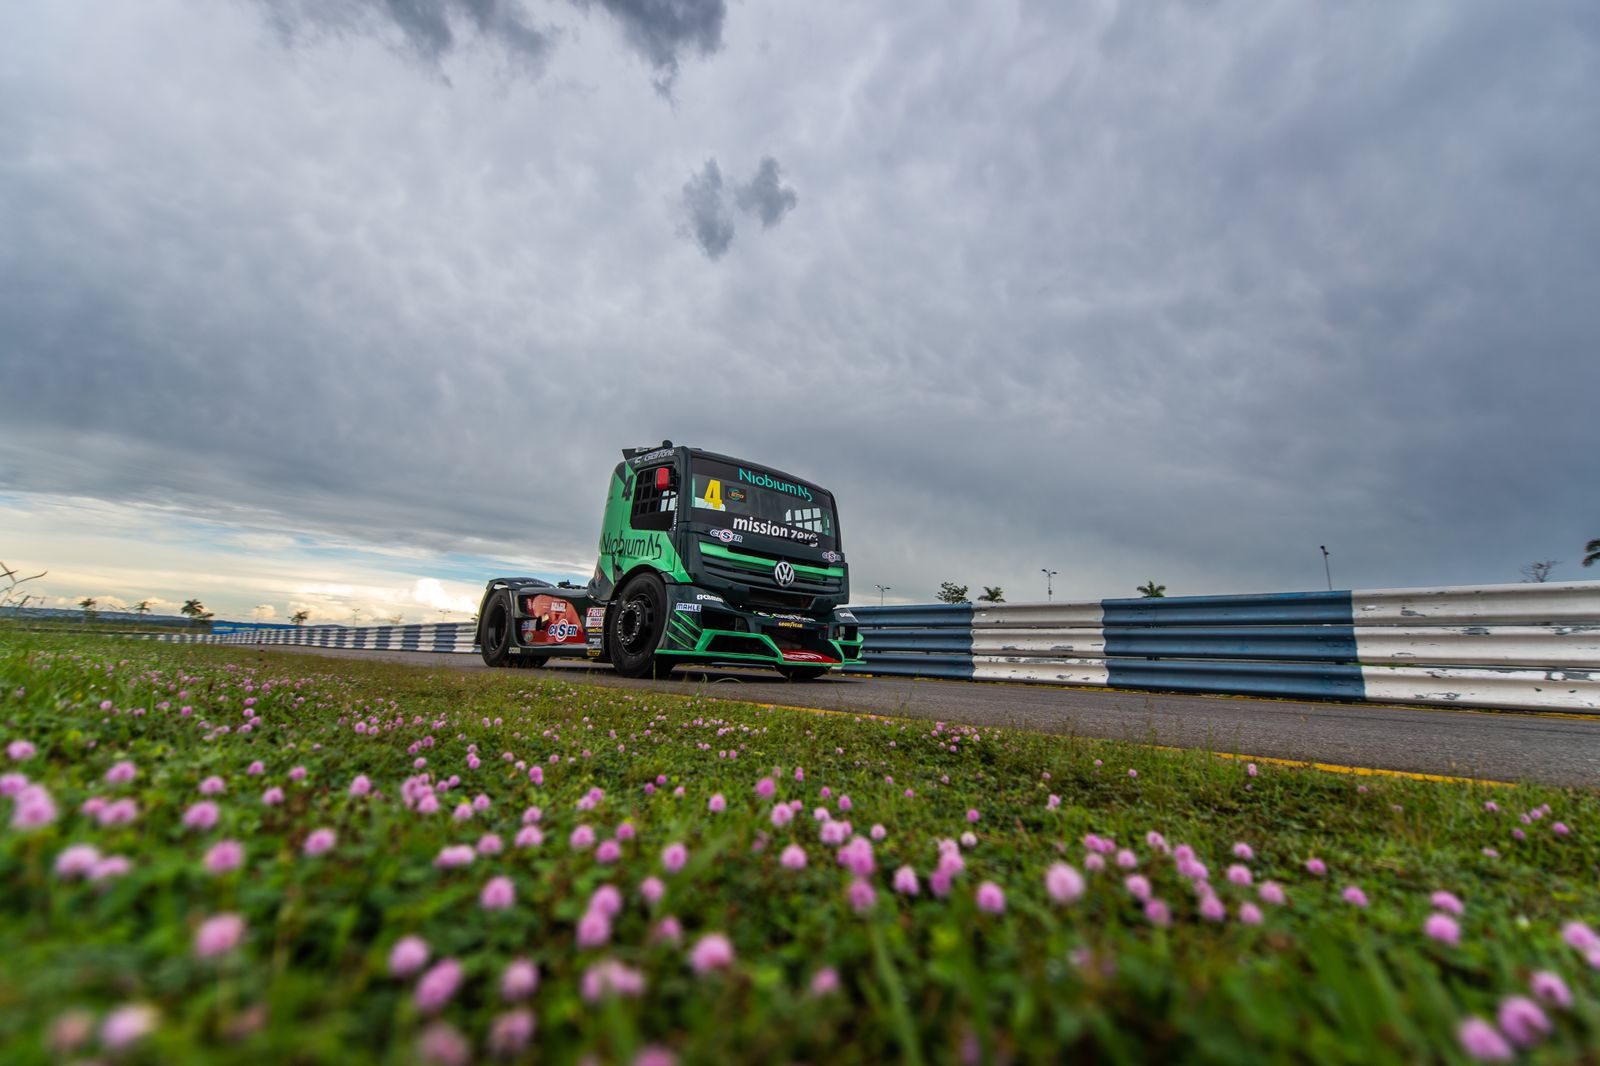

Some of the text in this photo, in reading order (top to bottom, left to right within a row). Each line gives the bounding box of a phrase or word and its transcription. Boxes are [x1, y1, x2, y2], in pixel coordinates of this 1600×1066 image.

[703, 479, 723, 509] 4
[733, 516, 788, 538] mission
[677, 603, 701, 612] MAHLE
[548, 619, 578, 641] CISER
